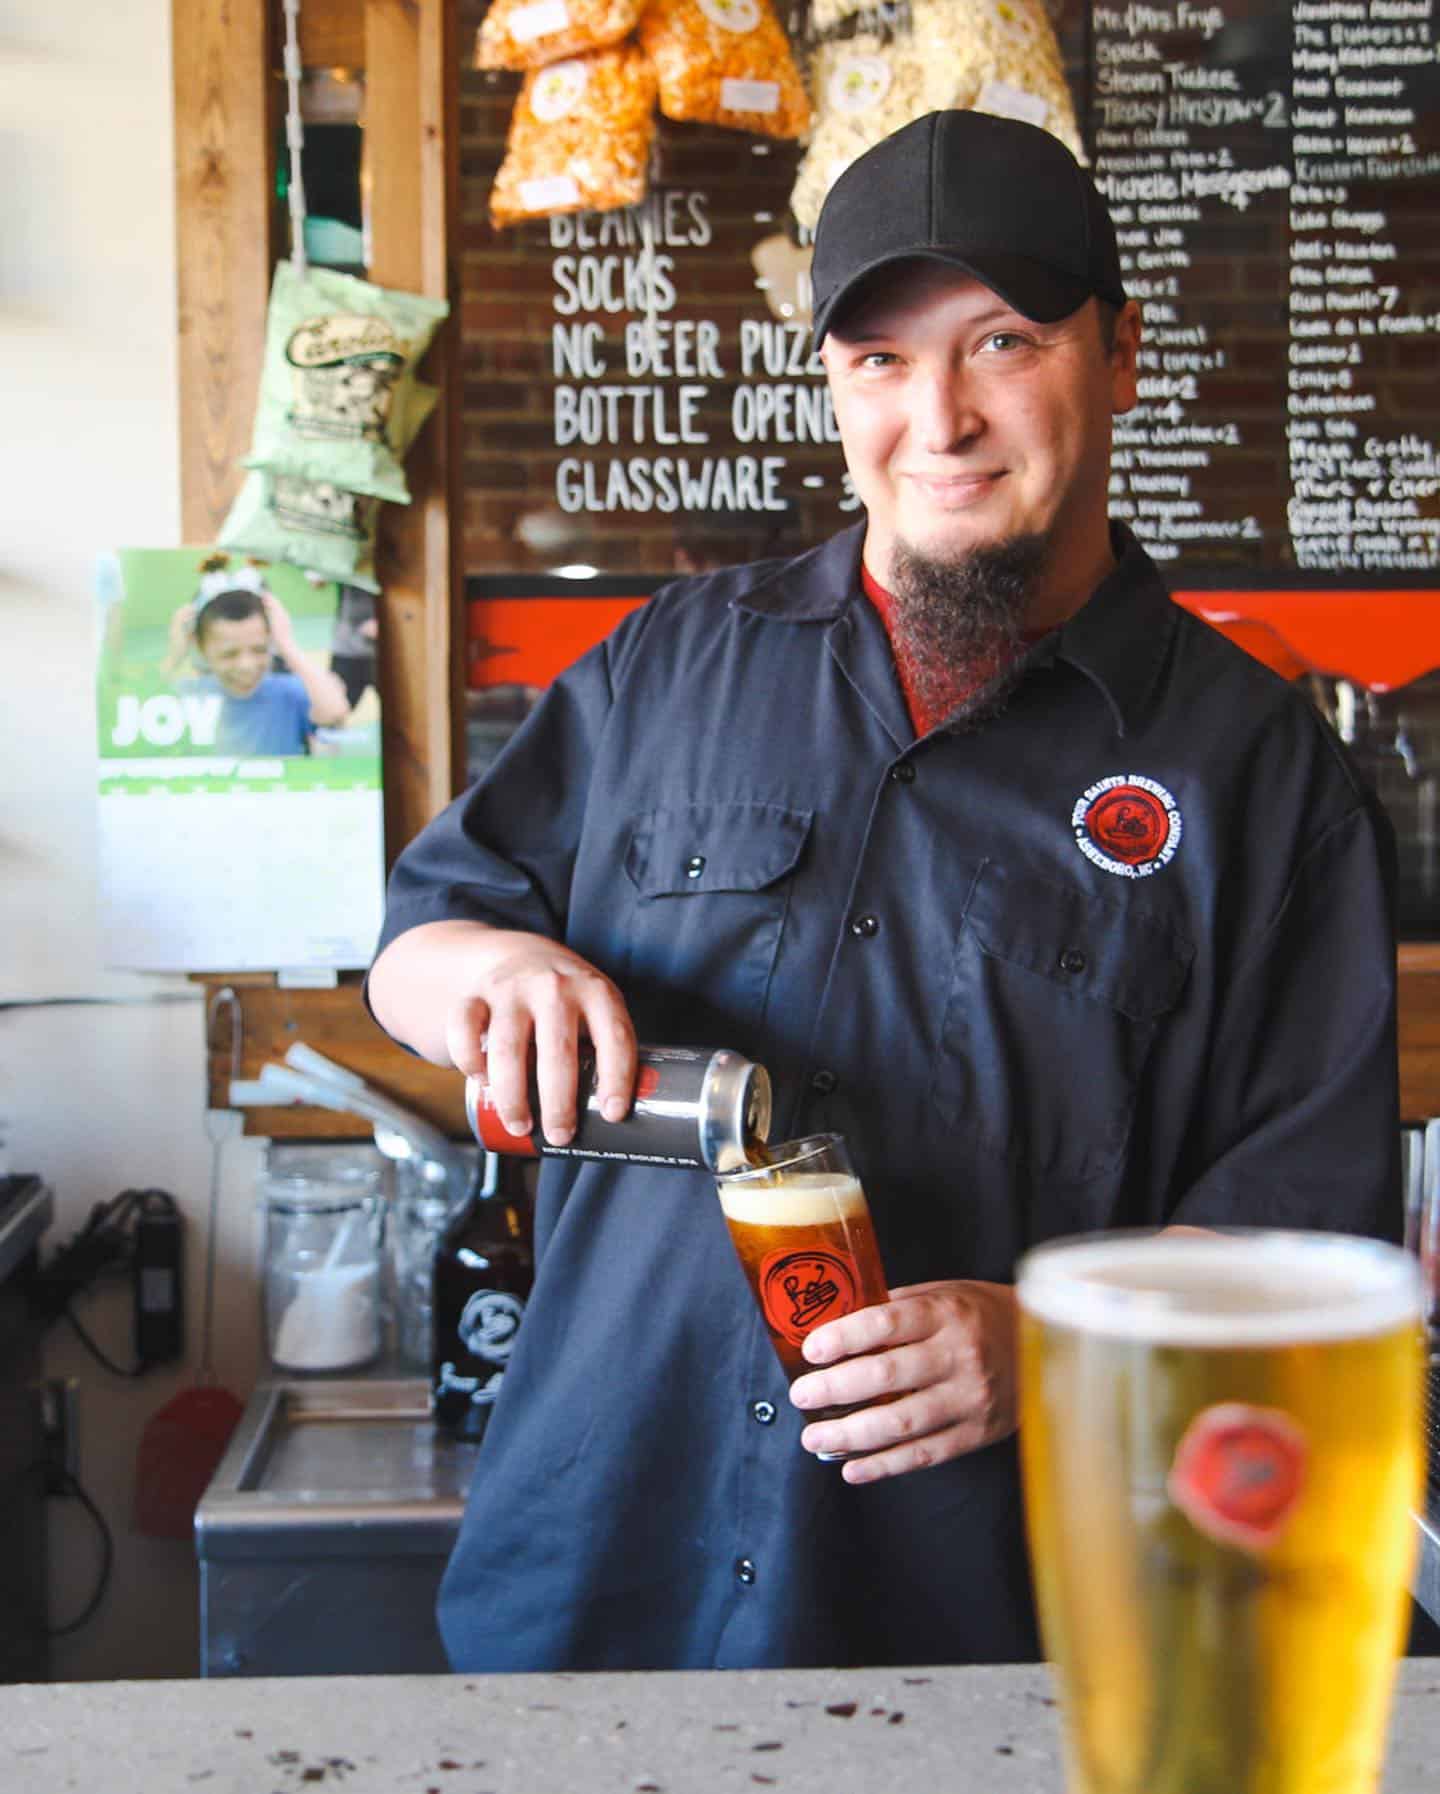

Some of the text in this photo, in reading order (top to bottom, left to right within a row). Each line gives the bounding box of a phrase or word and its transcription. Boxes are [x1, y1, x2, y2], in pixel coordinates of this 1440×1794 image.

[552, 254, 677, 315] SOCKS
[552, 321, 605, 378] NC
[625, 319, 724, 378] BEER
[554, 384, 709, 445] BOTTLE
[556, 456, 787, 512] GLASSWARE
[111, 694, 223, 748] JOY
[1072, 774, 1182, 865] FOUR SAINTS BREWING COMPANY
[571, 1149, 628, 1160] ENGLAND
[628, 1154, 677, 1164] DOUBLE
